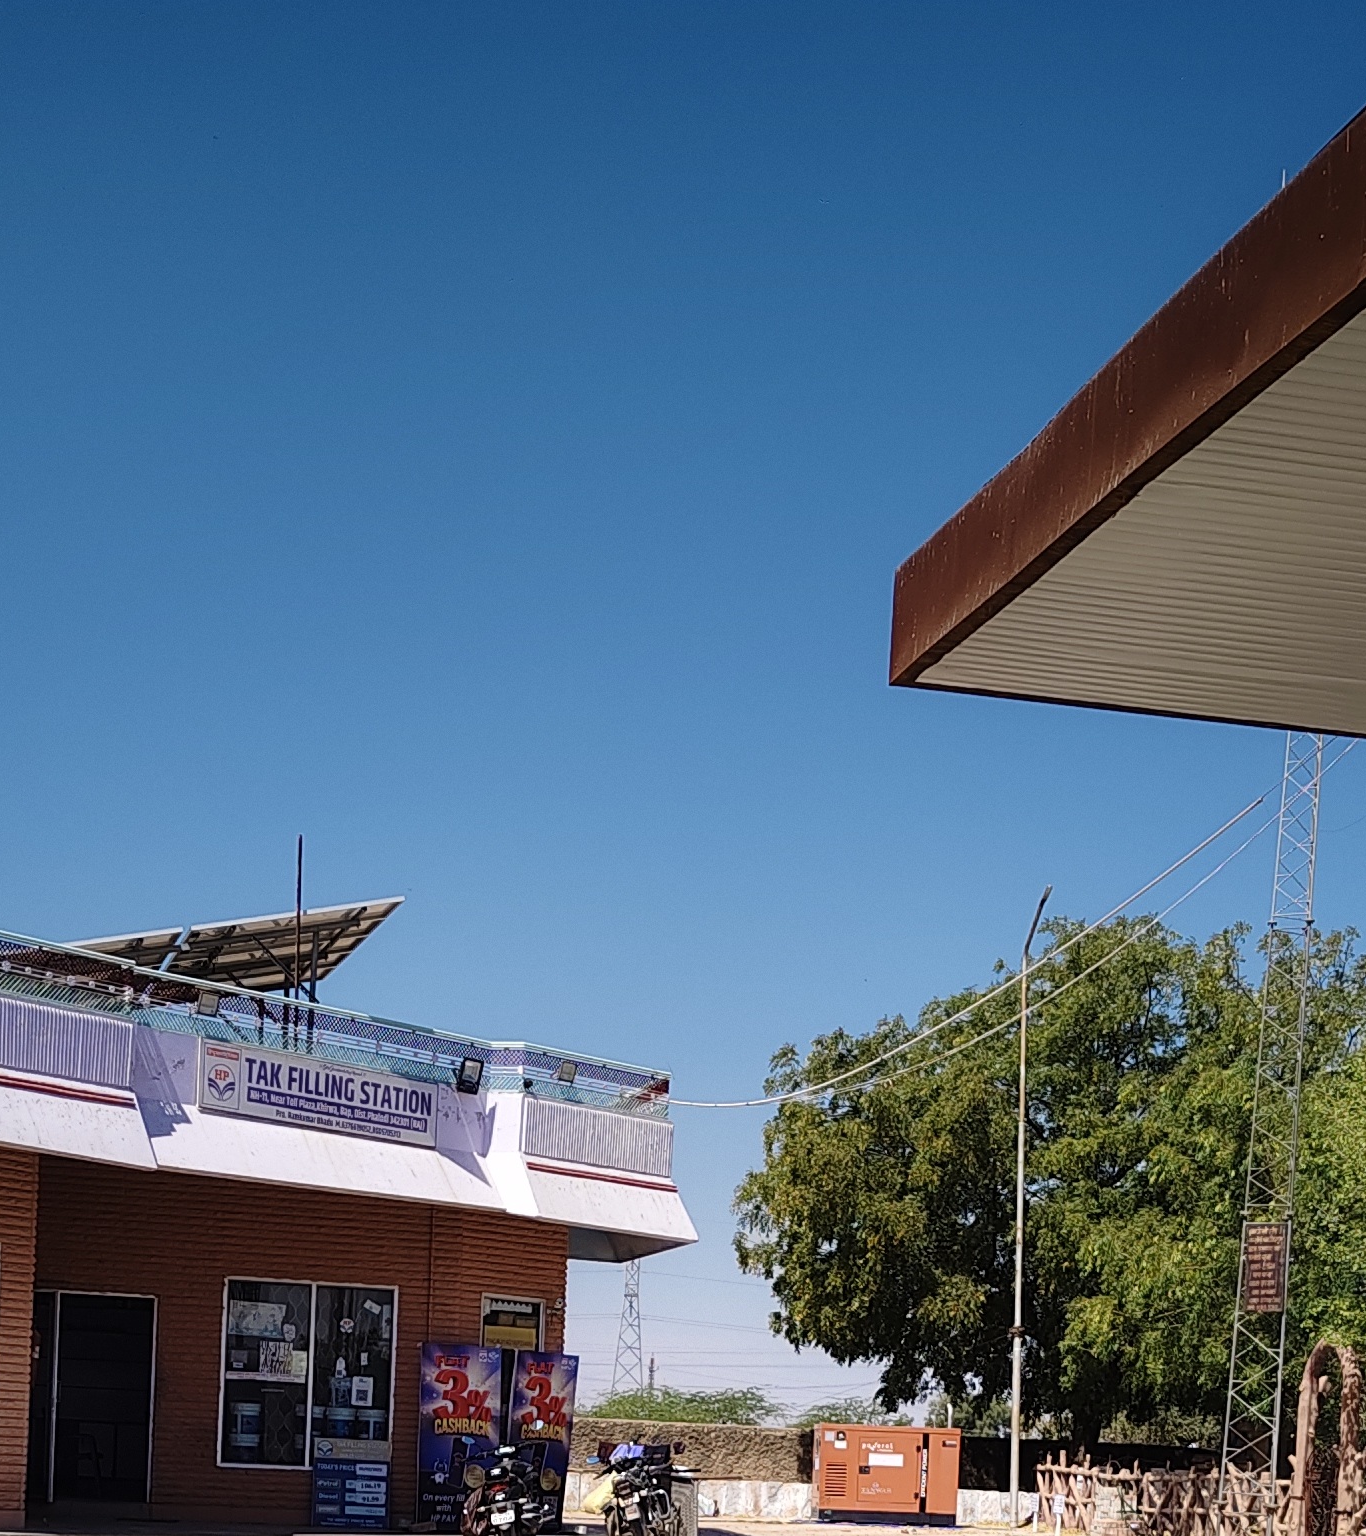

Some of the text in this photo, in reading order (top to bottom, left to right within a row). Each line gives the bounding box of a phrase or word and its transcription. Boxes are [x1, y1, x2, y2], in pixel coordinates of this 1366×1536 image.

[214, 1068, 230, 1081] HP
[245, 1057, 282, 1089] TAK
[287, 1065, 355, 1103] FILLING
[359, 1080, 432, 1117] STATION
[270, 1093, 286, 1106] Near
[527, 1361, 555, 1375] FLAT
[432, 1368, 493, 1422] 3%
[521, 1375, 568, 1427] 3%
[434, 1416, 492, 1436] CASHBACK
[339, 1463, 355, 1472] PRICE
[422, 1493, 433, 1501] On
[434, 1495, 455, 1503] every
[435, 1504, 452, 1512] with
[441, 1514, 457, 1522] PAY
